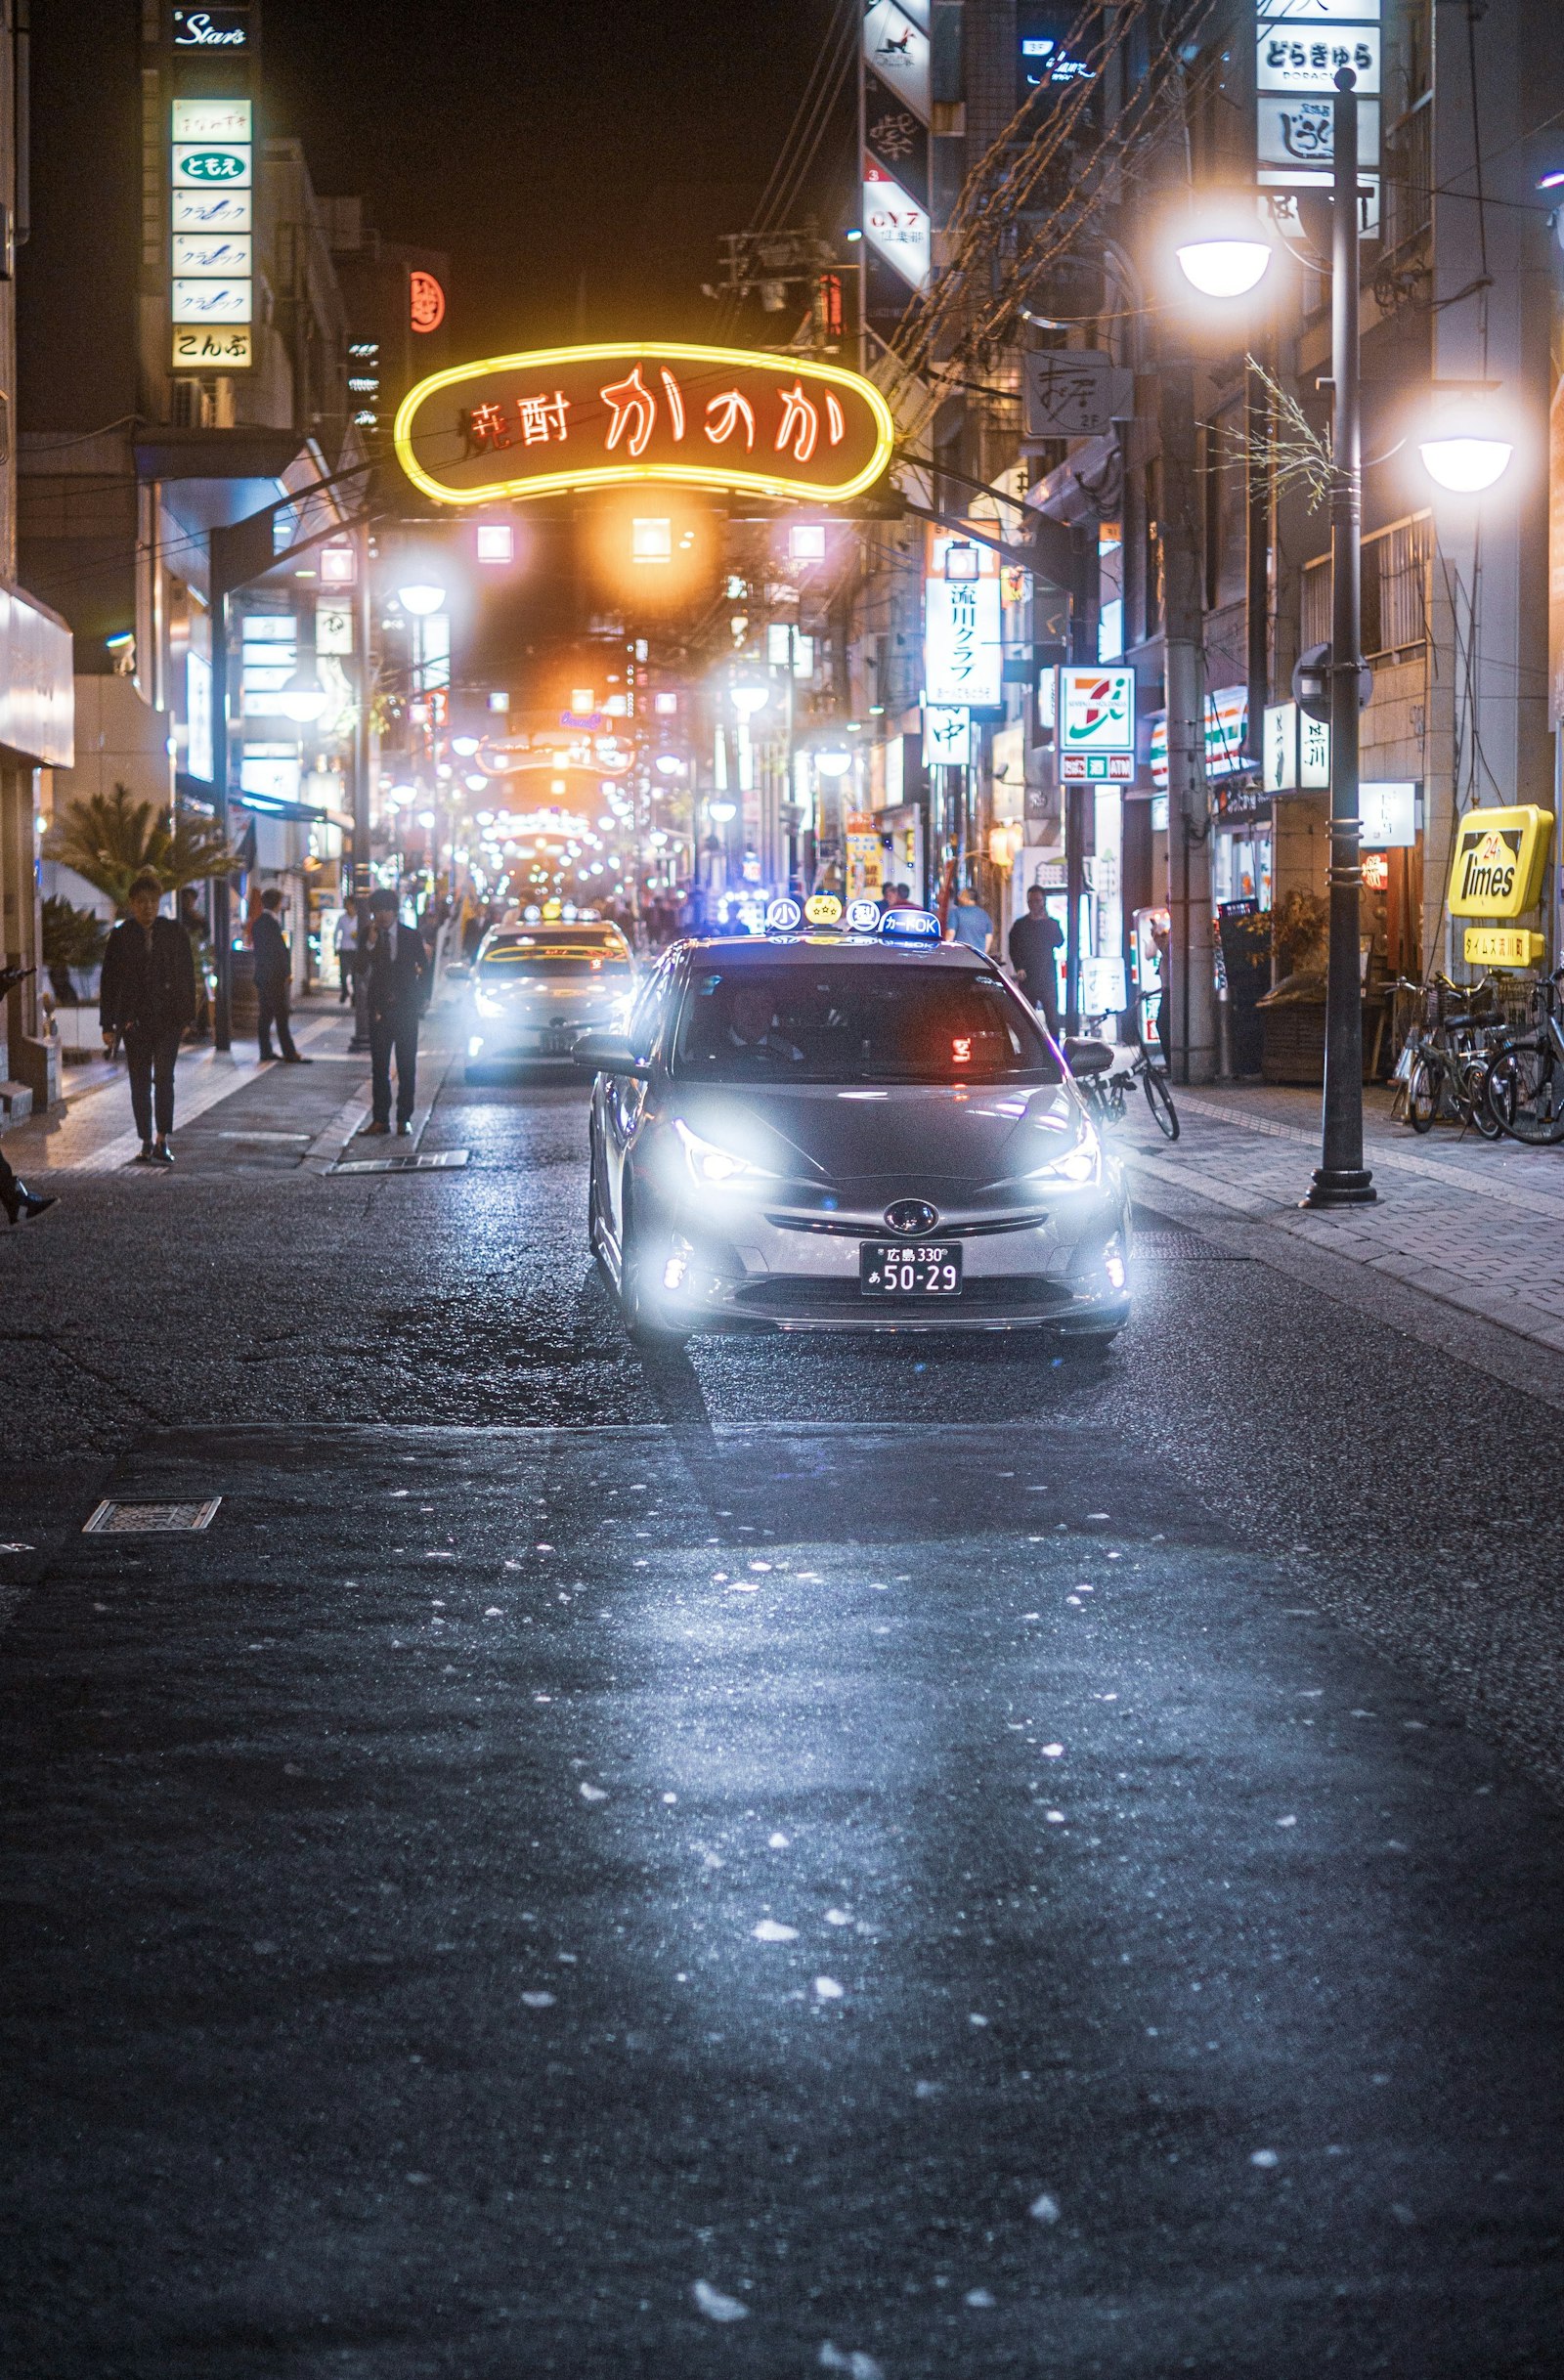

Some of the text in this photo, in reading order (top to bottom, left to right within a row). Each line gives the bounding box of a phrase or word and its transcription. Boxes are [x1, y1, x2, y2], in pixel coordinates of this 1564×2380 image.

[1267, 40, 1372, 70] どらきゅら
[187, 157, 239, 177] ともえ
[599, 361, 846, 463] かのか
[950, 584, 977, 681] 流川クラブ
[1460, 852, 1515, 901] Times
[773, 903, 797, 924] 小
[853, 904, 876, 925] 型
[885, 916, 937, 933] カードOK
[887, 1248, 942, 1262] 広島 330
[868, 1264, 957, 1290] あ 50-29
